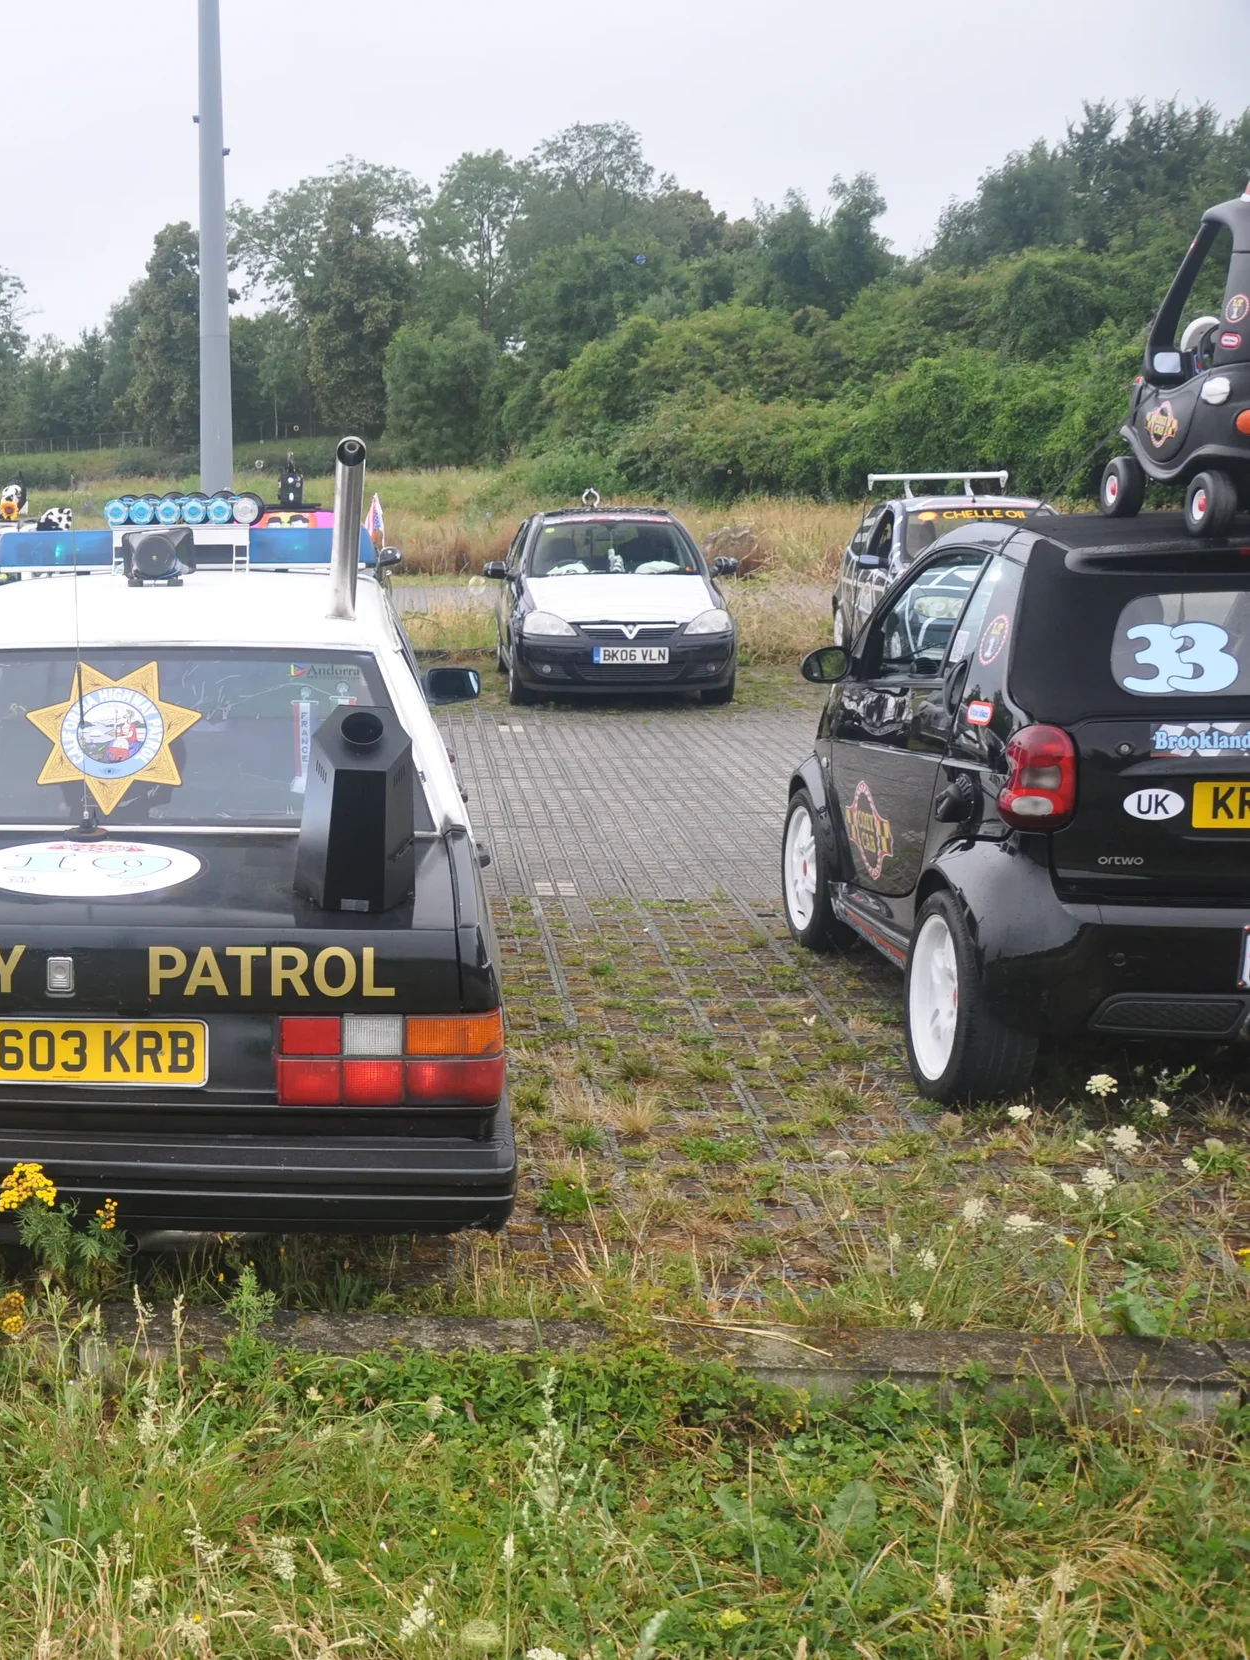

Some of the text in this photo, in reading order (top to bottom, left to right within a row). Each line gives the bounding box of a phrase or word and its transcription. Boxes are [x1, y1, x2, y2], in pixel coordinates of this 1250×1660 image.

[942, 509, 1004, 519] CHELLE
[307, 664, 361, 676] Andorra
[603, 649, 666, 662] BK06 VLN
[1122, 621, 1241, 694] 33
[98, 688, 160, 717] HIGHWAY
[136, 717, 163, 765] PATROL
[301, 711, 309, 763] FRANCE
[1137, 793, 1171, 815] UK
[148, 946, 396, 998] PATROL
[103, 1030, 195, 1074] KRB
